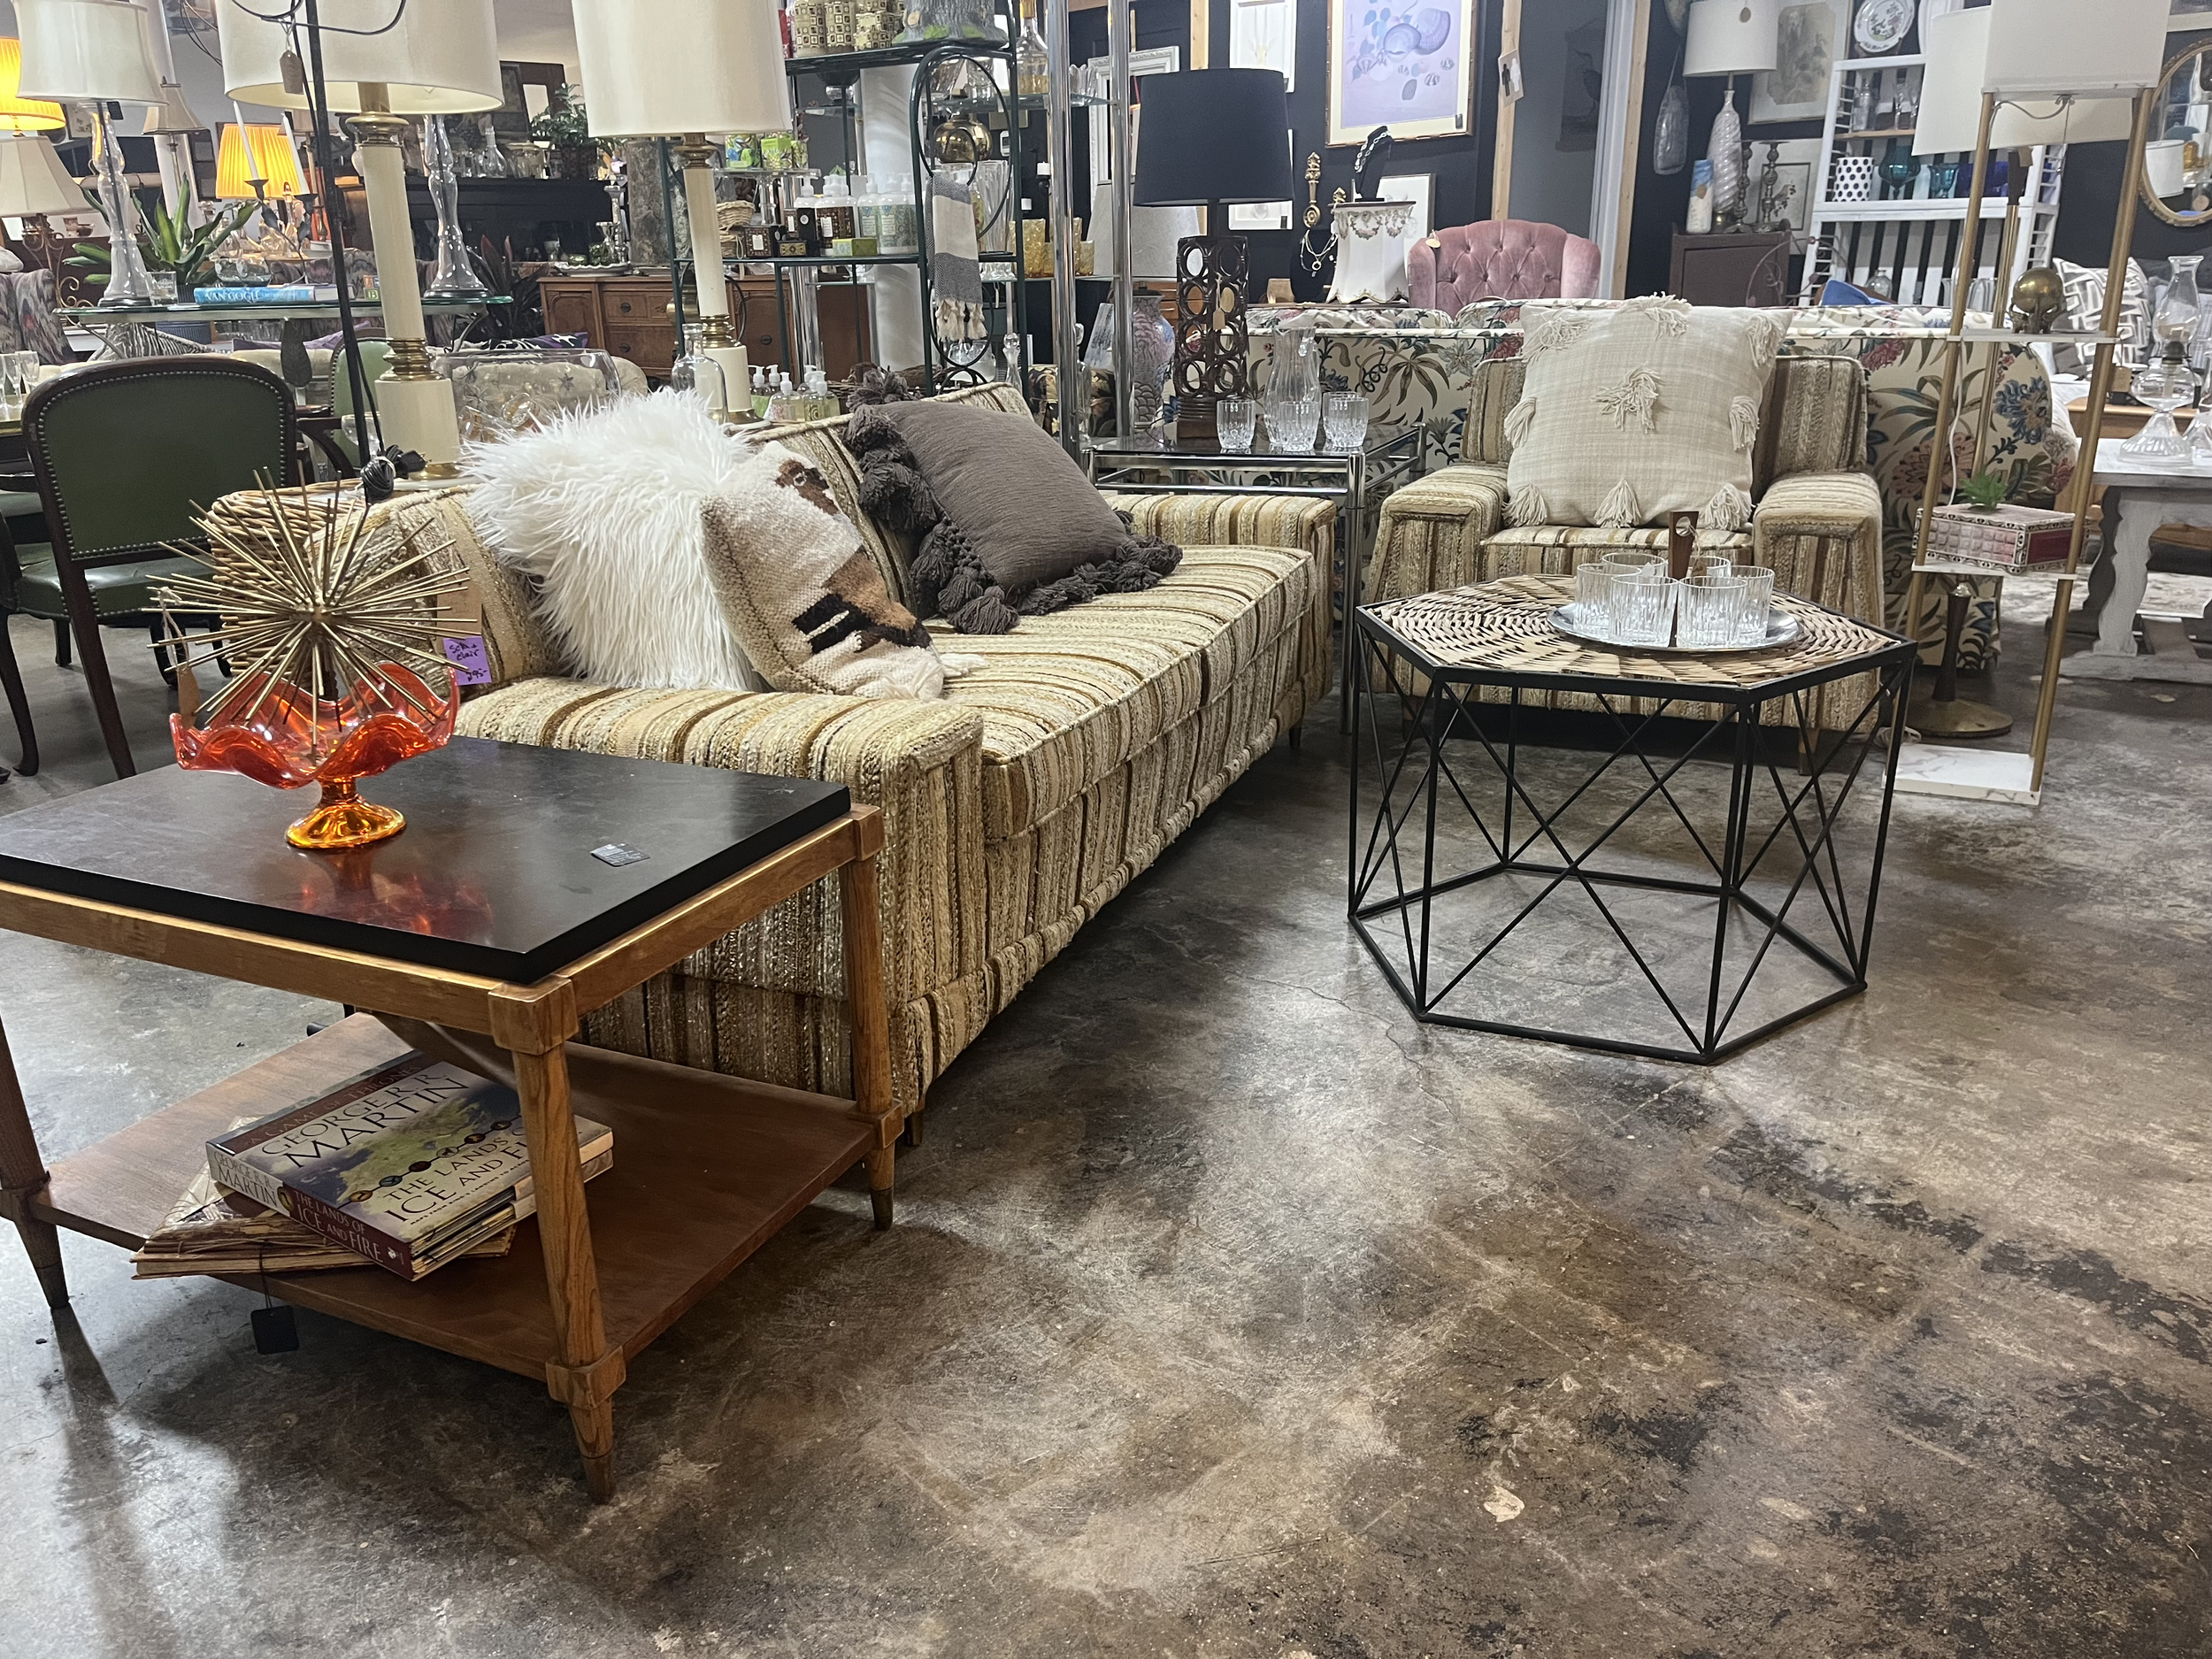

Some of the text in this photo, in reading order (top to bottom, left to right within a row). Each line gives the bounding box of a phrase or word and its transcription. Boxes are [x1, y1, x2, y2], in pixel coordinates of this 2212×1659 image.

[204, 290, 226, 302] VAN
[262, 1072, 447, 1156] GEORGE R. R.
[265, 1110, 319, 1137] GAME
[325, 1101, 342, 1111] OF
[348, 1064, 423, 1102] THRONES
[283, 1077, 470, 1169] MARTIN
[213, 1150, 251, 1178] GEORGE
[217, 1164, 279, 1208] MARTIN
[383, 1177, 434, 1202] THE
[434, 1136, 510, 1177] LANDS
[385, 1140, 529, 1223] ICE AND FI
[294, 1190, 365, 1235] THE LANDS OF
[296, 1203, 325, 1233] ICE
[326, 1224, 349, 1243] AND
[349, 1231, 384, 1264] FIRE
[429, 1204, 448, 1216] FROM
